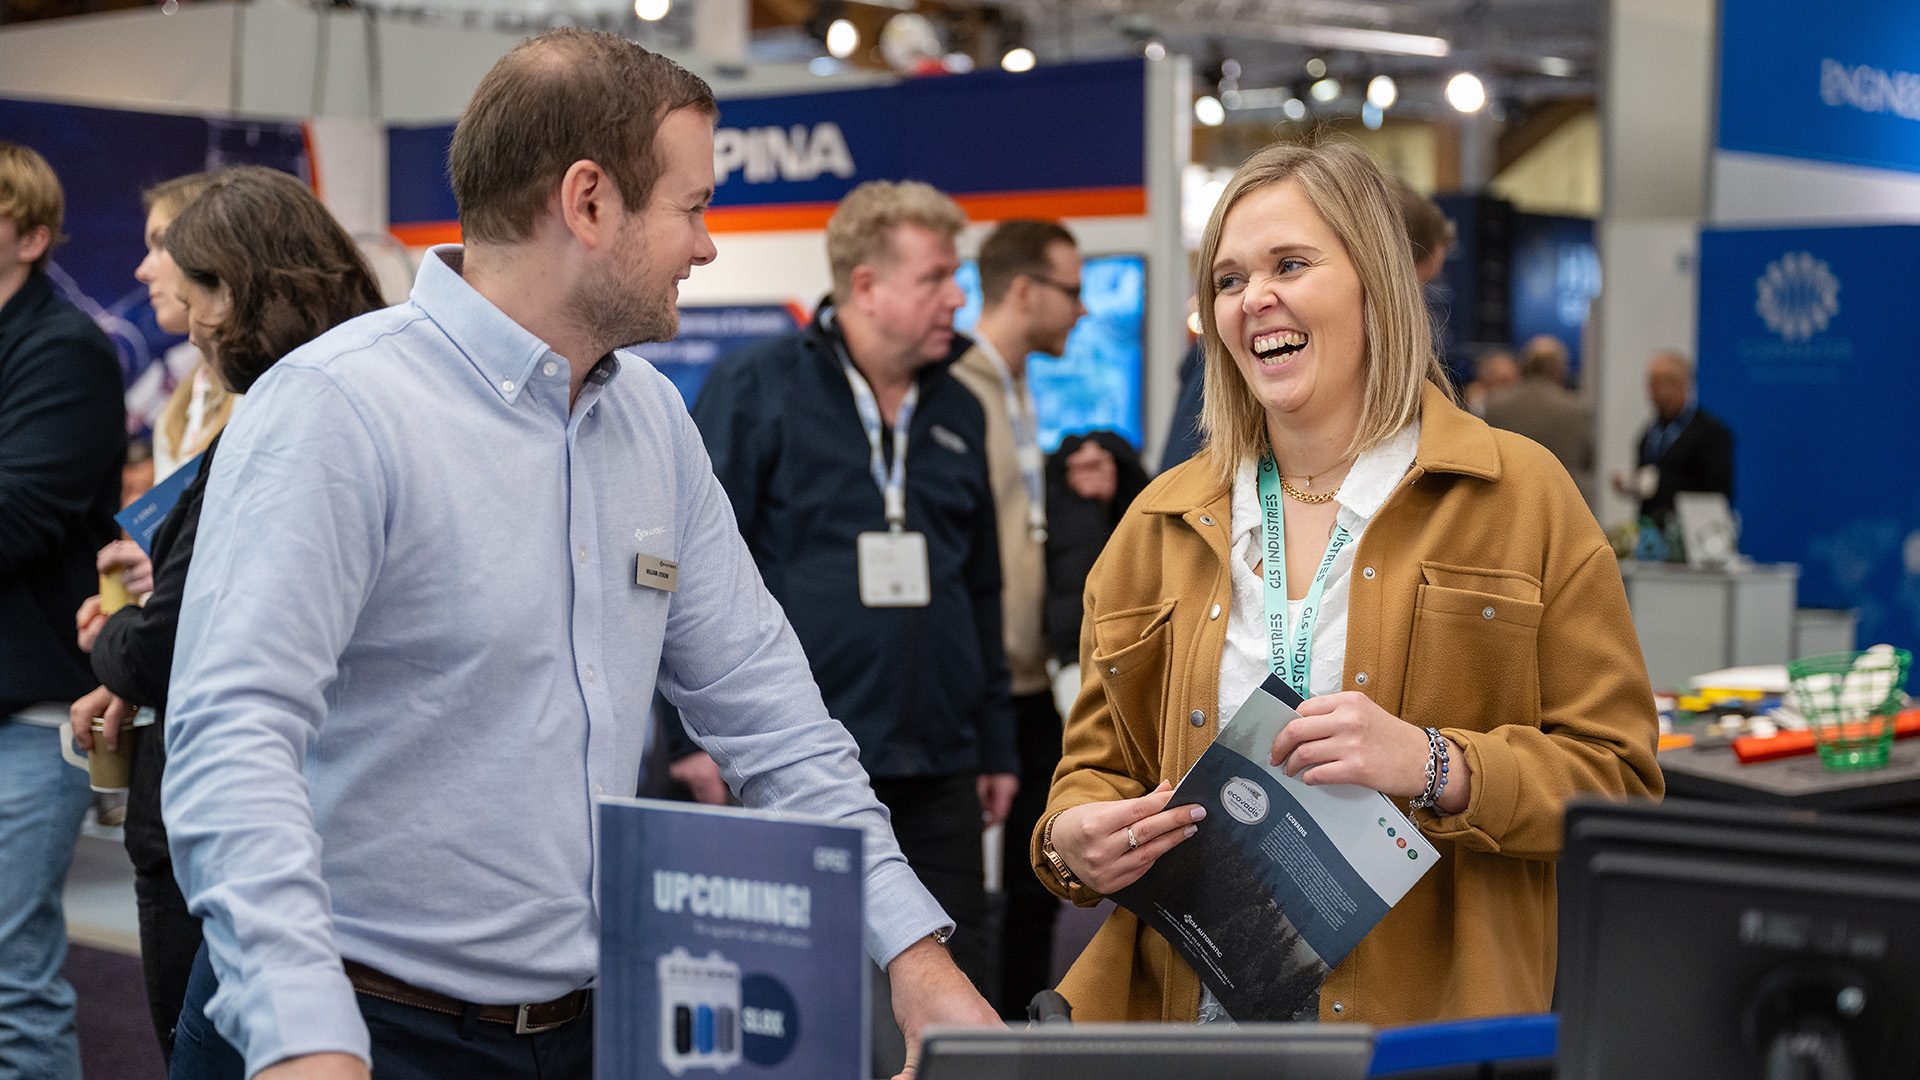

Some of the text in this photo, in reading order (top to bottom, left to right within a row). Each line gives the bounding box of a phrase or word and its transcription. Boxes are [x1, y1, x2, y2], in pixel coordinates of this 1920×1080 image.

[1265, 493, 1282, 589] GLS INDUSTRIES
[1316, 528, 1349, 582] USTRIES
[1271, 613, 1287, 681] DUSTRIES
[1292, 607, 1313, 696] GLS INDUST
[1227, 790, 1260, 818] ecovadis
[1285, 812, 1308, 837] ECOVADIS
[653, 869, 812, 929] UPCOMING!
[1196, 927, 1223, 958] AUTOMATIC
